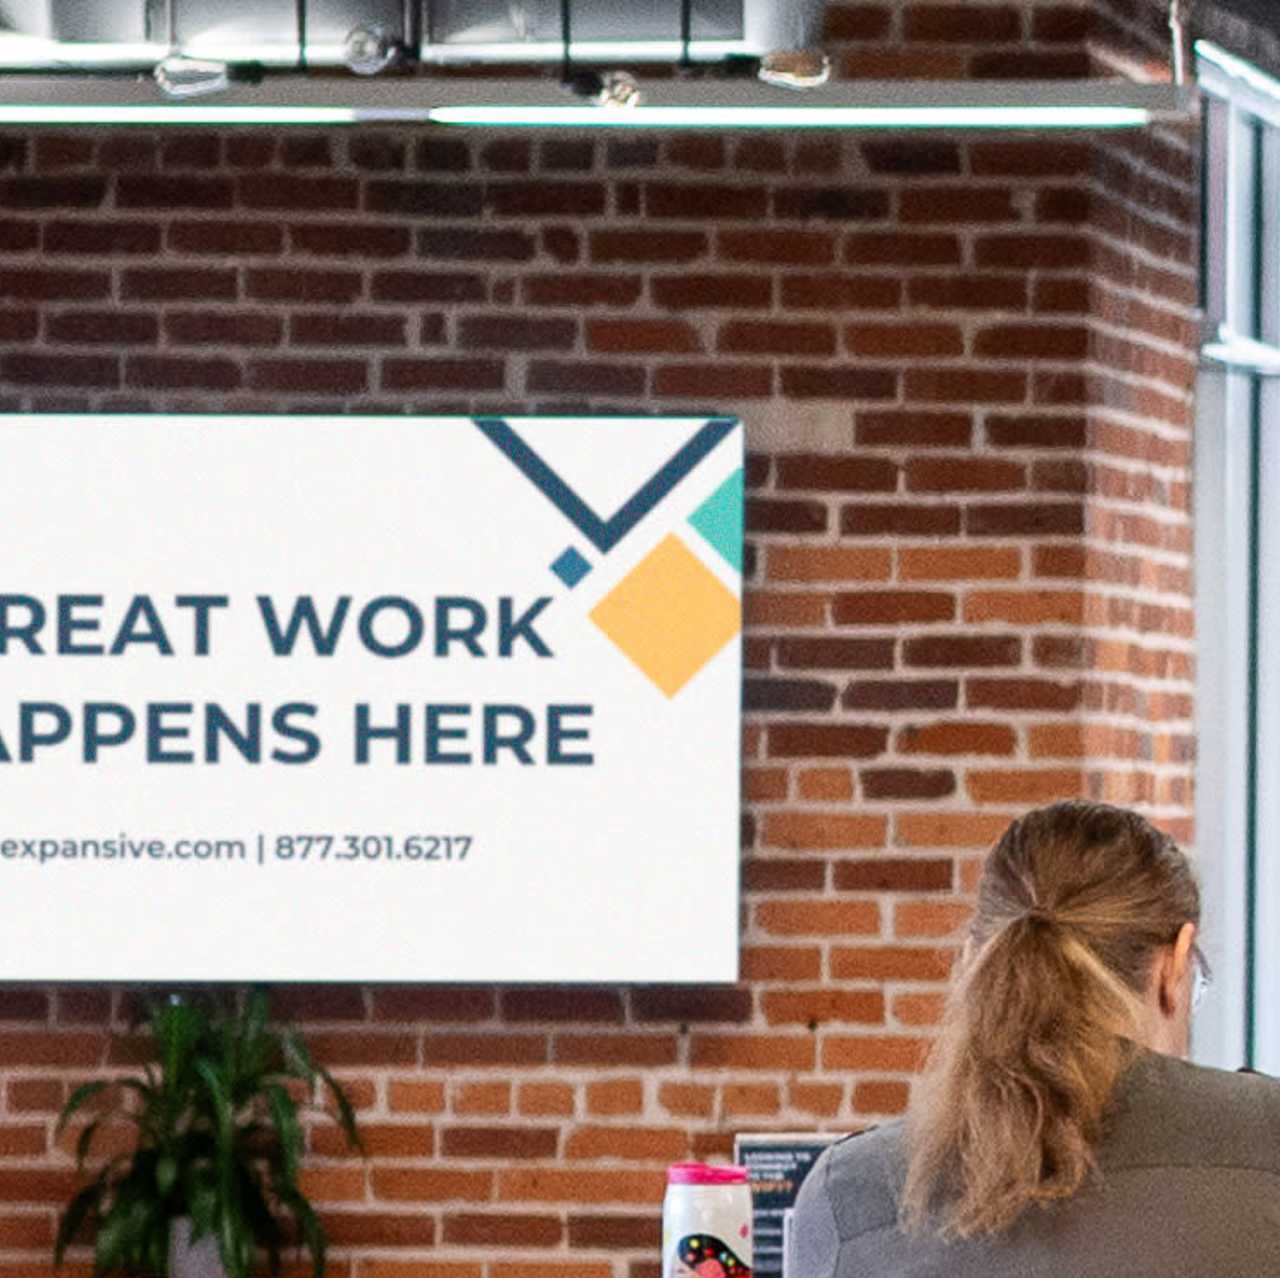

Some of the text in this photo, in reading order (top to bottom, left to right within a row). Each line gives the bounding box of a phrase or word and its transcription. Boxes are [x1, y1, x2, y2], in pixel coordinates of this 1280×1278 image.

[255, 595, 554, 659] WORK
[354, 702, 595, 766] HERE
[0, 832, 246, 864] expansive.com
[275, 834, 473, 861] 877.301.6217
